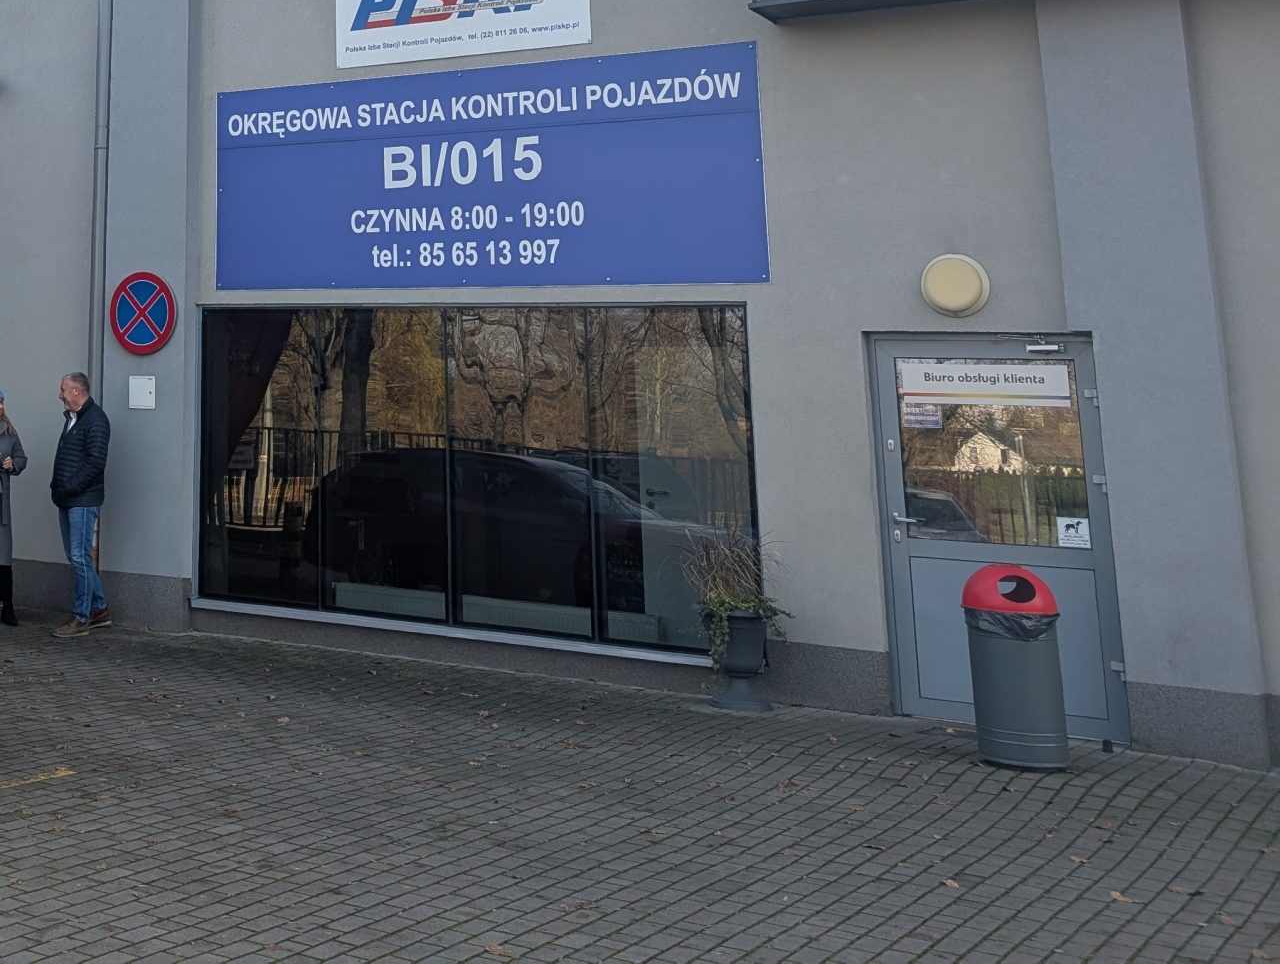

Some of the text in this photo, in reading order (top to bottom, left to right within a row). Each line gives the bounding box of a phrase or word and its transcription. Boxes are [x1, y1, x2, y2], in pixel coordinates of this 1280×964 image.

[419, 5, 441, 14] Polska
[345, 45, 366, 53] Polska
[382, 41, 400, 50] Stacji
[402, 38, 428, 47] Kontroli
[430, 34, 464, 45] Pojazdów,
[480, 31, 493, 39] (22)
[531, 21, 580, 33] www.piskp.pl
[228, 68, 741, 138] OKRĘGOWA STACJA KONTROLI POJAZDÓW
[383, 135, 542, 189] BI/015
[350, 207, 445, 234] CZYNNA
[450, 205, 498, 231] 8:00
[520, 201, 585, 228] 19:00
[372, 239, 560, 268] tel.: 85 65 13 997
[924, 372, 1045, 385] Biuro obsługi klienta
